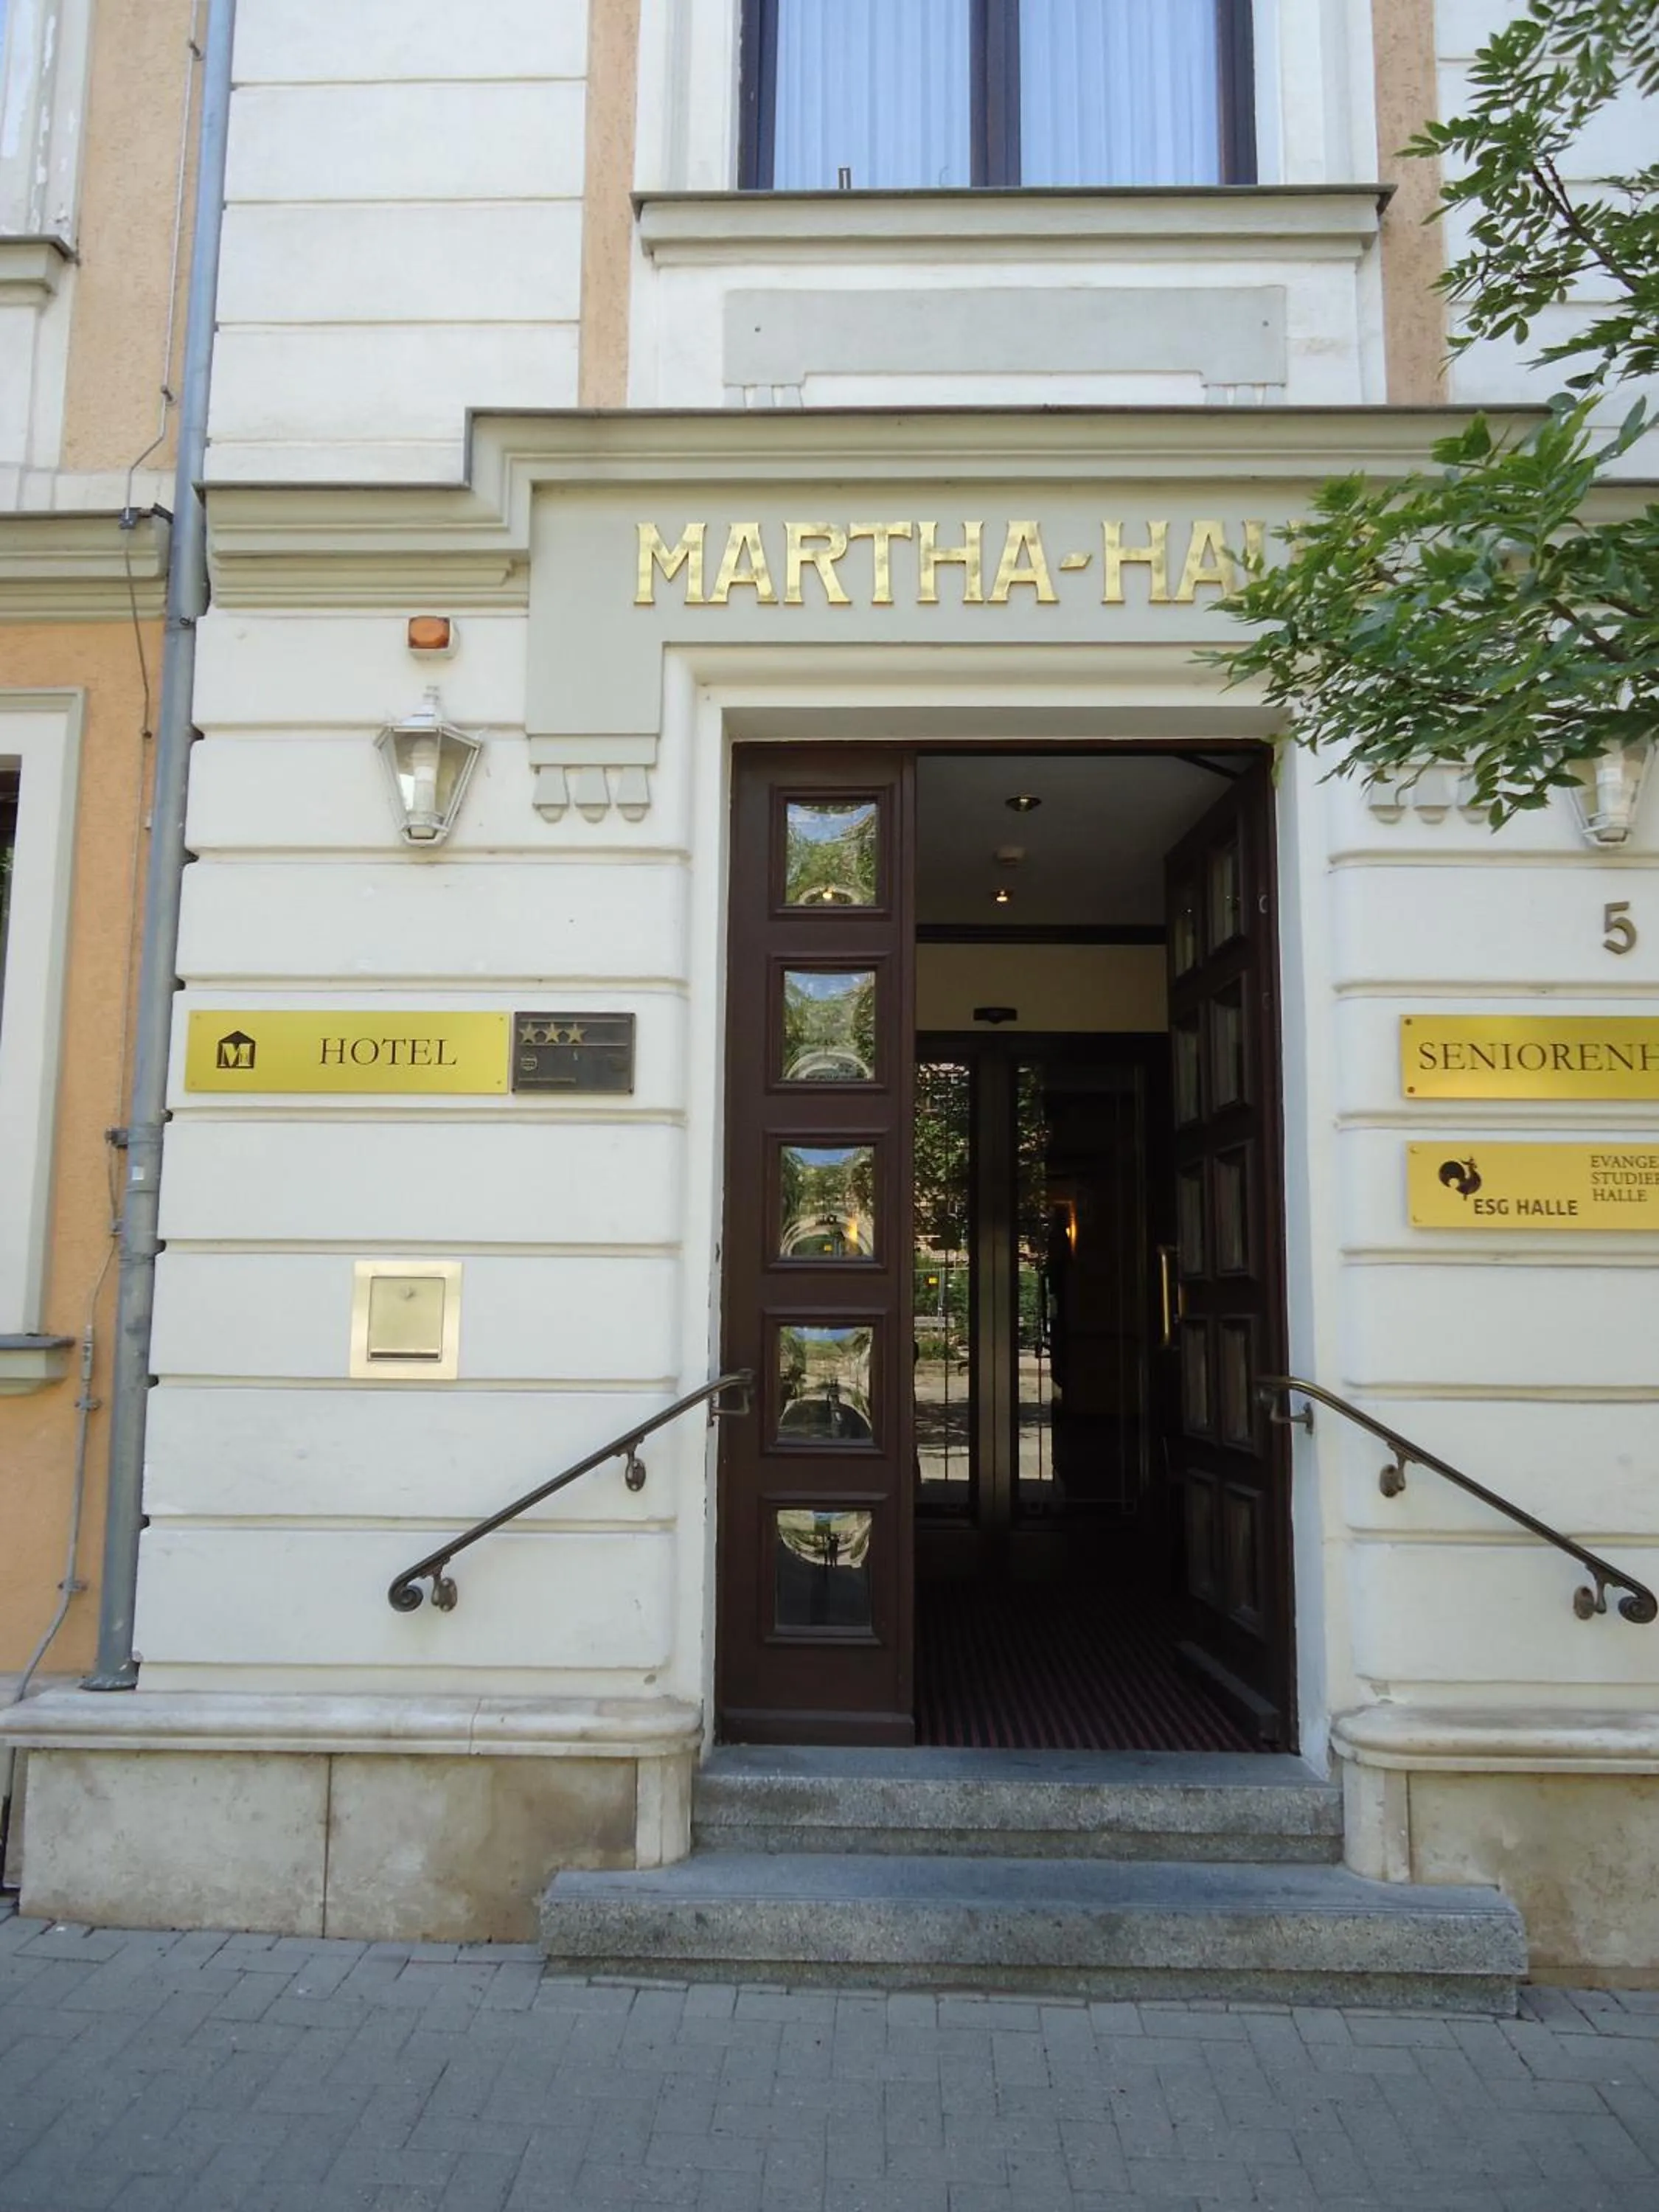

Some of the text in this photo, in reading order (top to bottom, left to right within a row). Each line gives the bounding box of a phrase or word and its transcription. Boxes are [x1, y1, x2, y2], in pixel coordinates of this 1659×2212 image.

[634, 519, 1383, 605] MARTHA-HA
[1603, 900, 1637, 955] 5
[319, 1037, 457, 1065] HOTEL
[1474, 1198, 1579, 1216] ESG HALLE
[1593, 1189, 1648, 1202] HALLE
